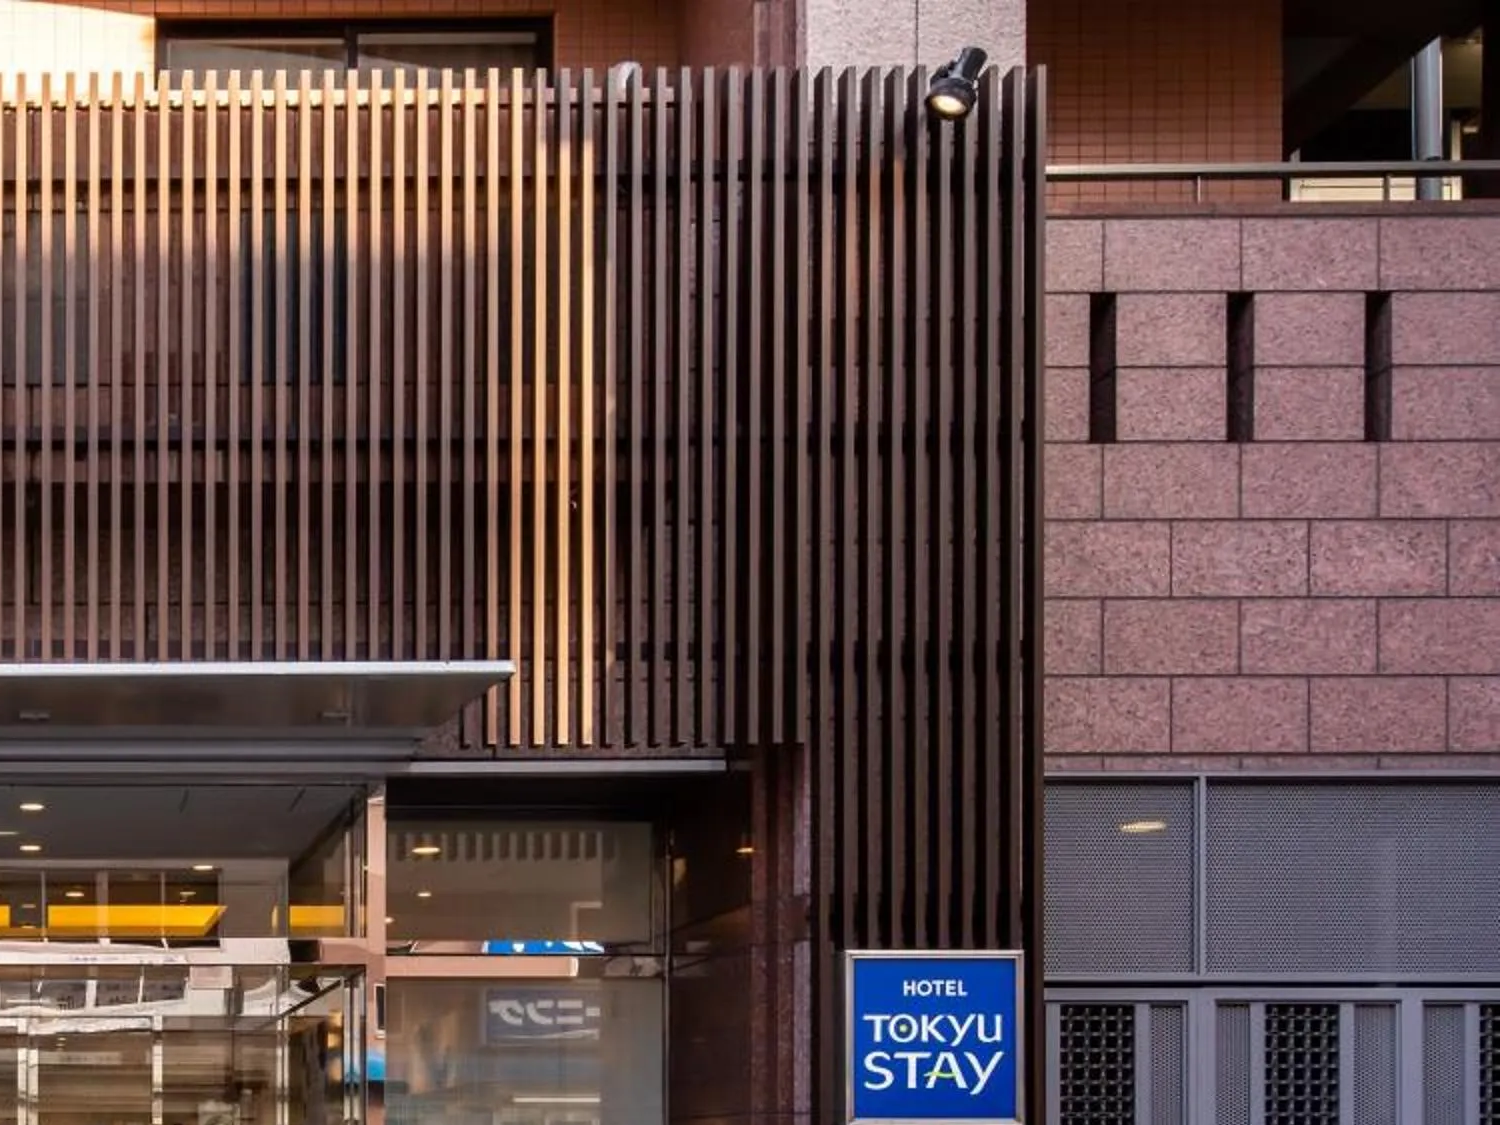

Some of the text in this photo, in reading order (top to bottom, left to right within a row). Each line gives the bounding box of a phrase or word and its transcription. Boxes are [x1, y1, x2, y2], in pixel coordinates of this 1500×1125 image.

[902, 979, 968, 997] HOTEL
[862, 1013, 1003, 1047] TOKYU
[862, 1051, 1005, 1095] STAY
